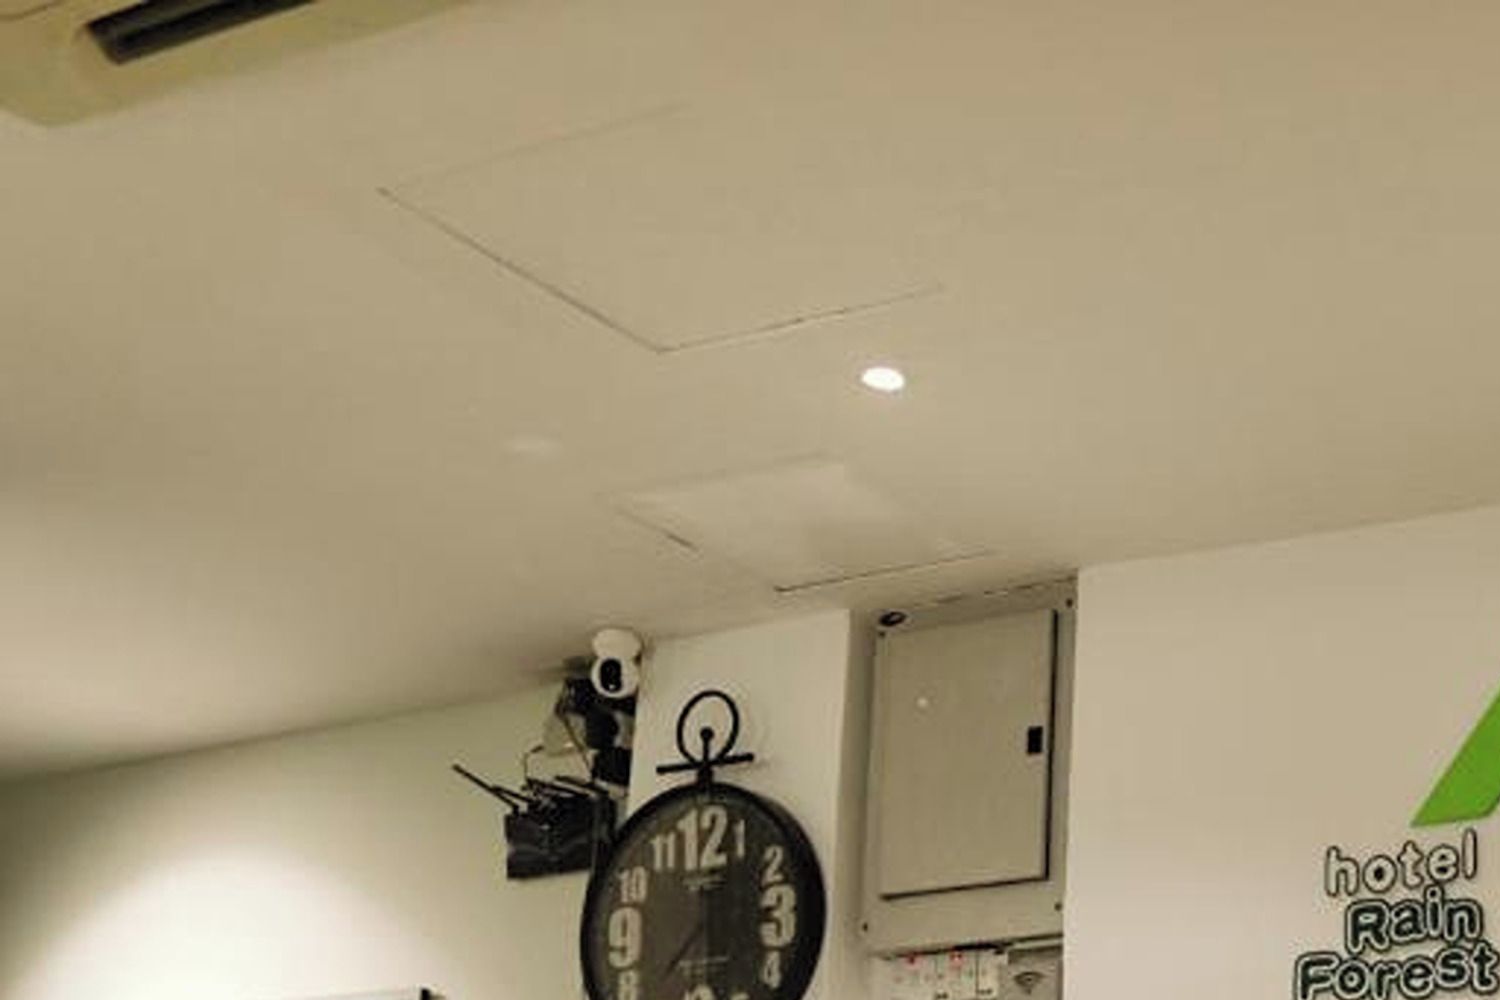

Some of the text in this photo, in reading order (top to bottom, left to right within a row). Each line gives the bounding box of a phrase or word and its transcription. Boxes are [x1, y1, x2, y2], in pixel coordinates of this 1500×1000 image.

[651, 832, 676, 872] 11
[678, 804, 727, 870] 12
[734, 819, 746, 857] 1
[1324, 828, 1478, 897] hotel
[618, 866, 648, 903] 10
[763, 846, 784, 882] 2
[608, 906, 642, 968] 9
[761, 885, 796, 947] 3
[1346, 883, 1484, 953] Rain
[763, 951, 781, 988] 4
